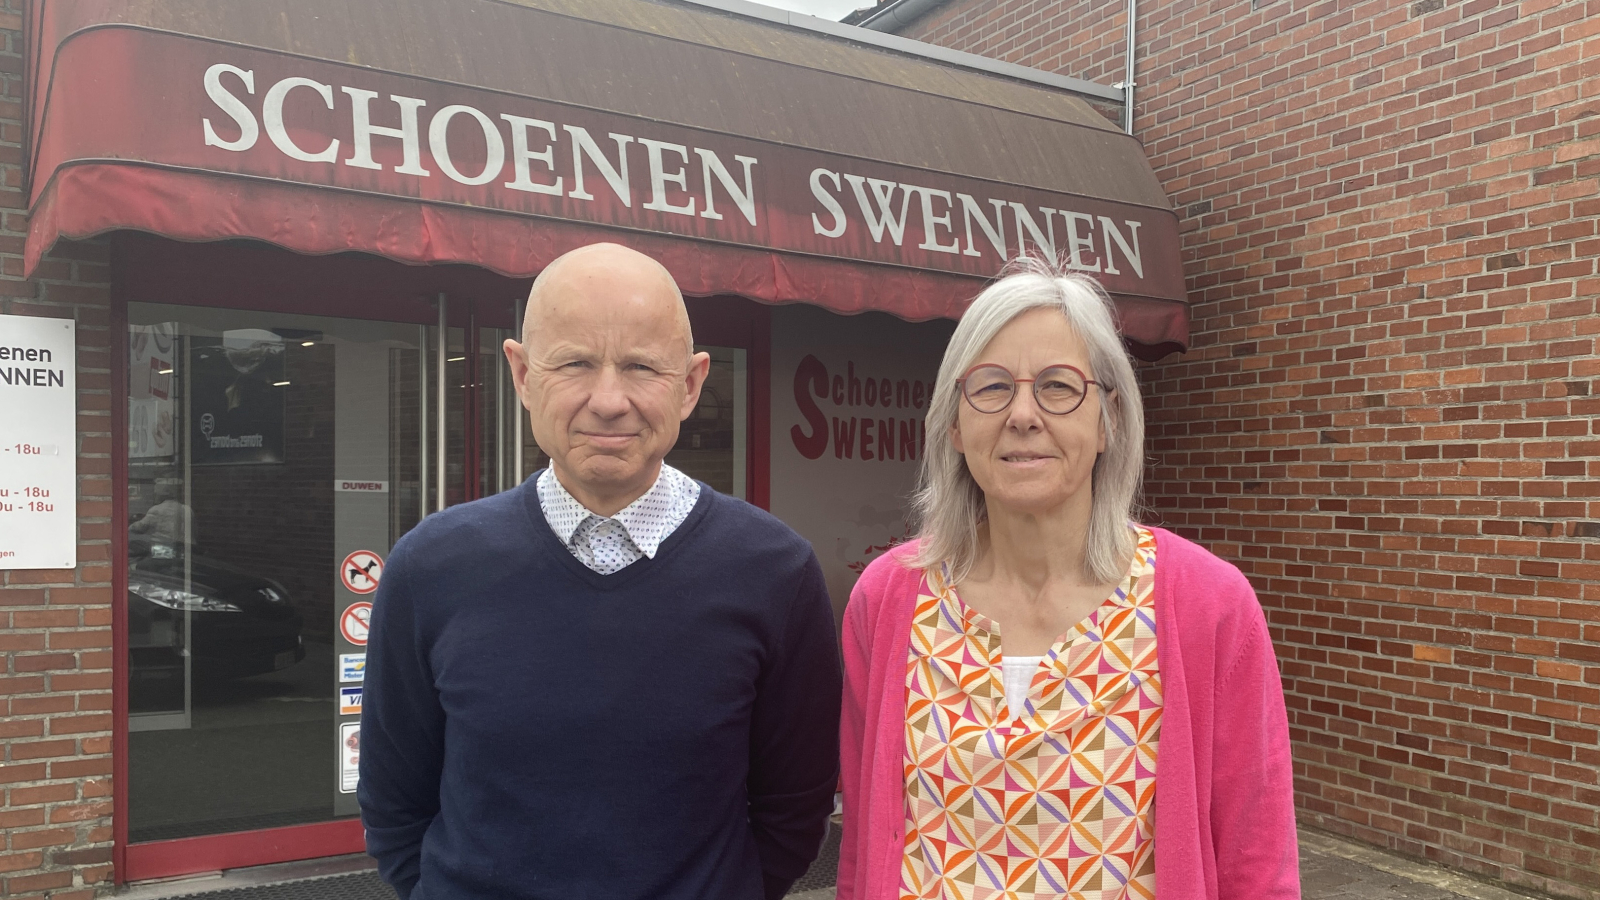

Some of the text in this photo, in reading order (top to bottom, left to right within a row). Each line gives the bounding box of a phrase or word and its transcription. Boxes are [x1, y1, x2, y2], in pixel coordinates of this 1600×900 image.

[202, 63, 1144, 279] SCHOENEN SWENNEN
[15, 443, 41, 455] 18u
[342, 482, 382, 490] DUWEN
[24, 486, 50, 498] 18u
[28, 501, 54, 512] 18u
[350, 695, 362, 705] VI
